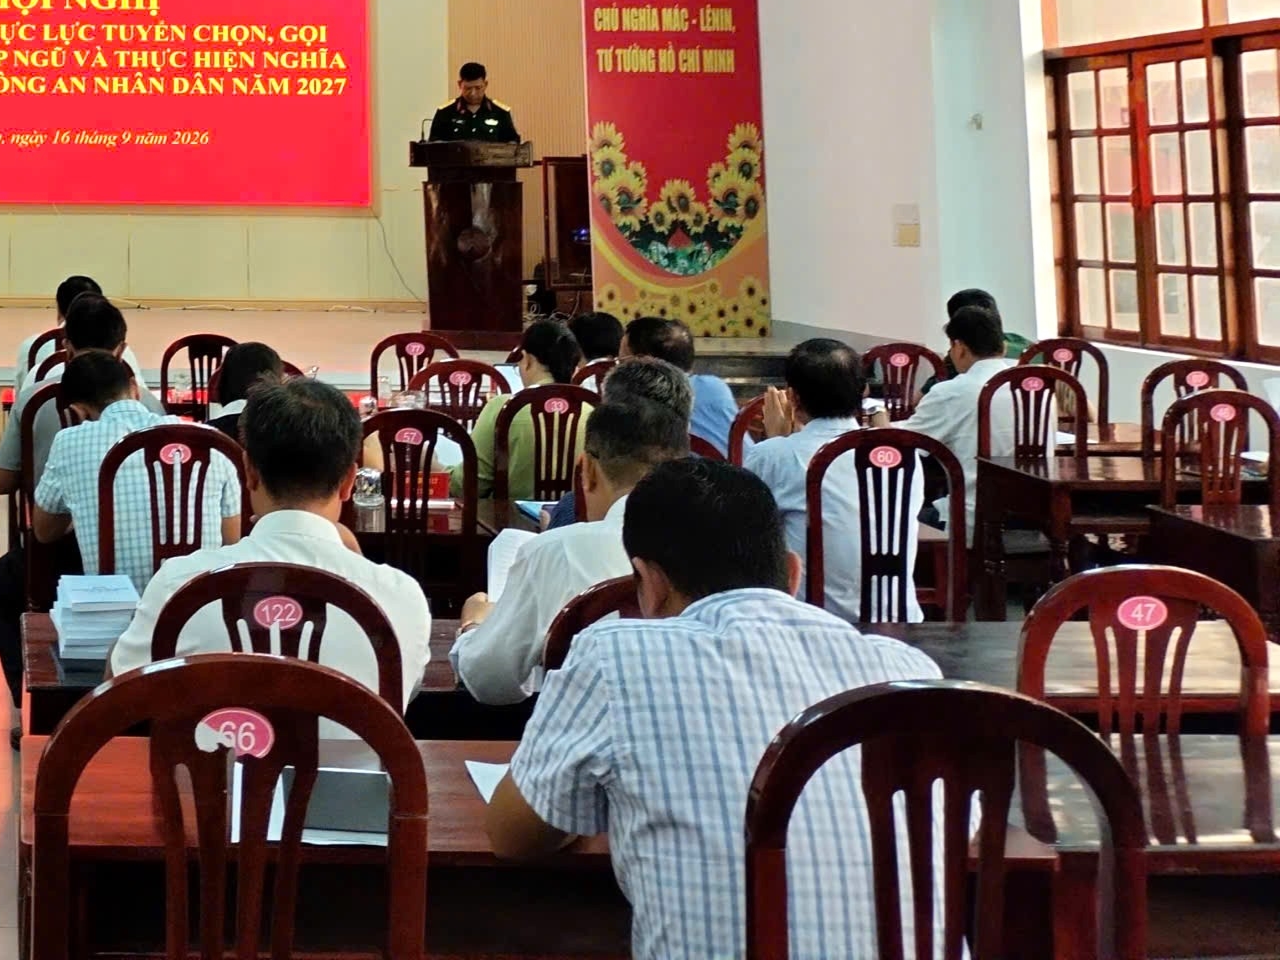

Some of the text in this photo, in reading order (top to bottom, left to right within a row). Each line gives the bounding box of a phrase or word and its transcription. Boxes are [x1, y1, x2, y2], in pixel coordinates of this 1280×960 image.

[44, 22, 95, 45] LỰC
[194, 25, 273, 46] CHỌN,
[280, 26, 326, 45] GỌI
[14, 47, 65, 67] NGŨ
[74, 46, 107, 67] VÀ
[114, 48, 186, 71] THỰC
[195, 49, 254, 71] HIỆN
[264, 48, 345, 68] NGHĨA
[53, 77, 85, 93] AN
[94, 72, 164, 93] NHÂN
[173, 72, 223, 94] DÂN
[232, 74, 288, 94] NĂM
[298, 78, 346, 94] 2027
[11, 131, 46, 146] ngày
[54, 131, 70, 143] 16
[75, 131, 117, 146] tháng
[122, 132, 131, 143] 9
[136, 133, 167, 144] năm
[172, 132, 208, 144] 2026
[403, 431, 417, 441] 57
[876, 451, 893, 463] 60
[261, 602, 297, 622] 122
[1130, 603, 1157, 622] 47
[219, 721, 256, 751] 66
